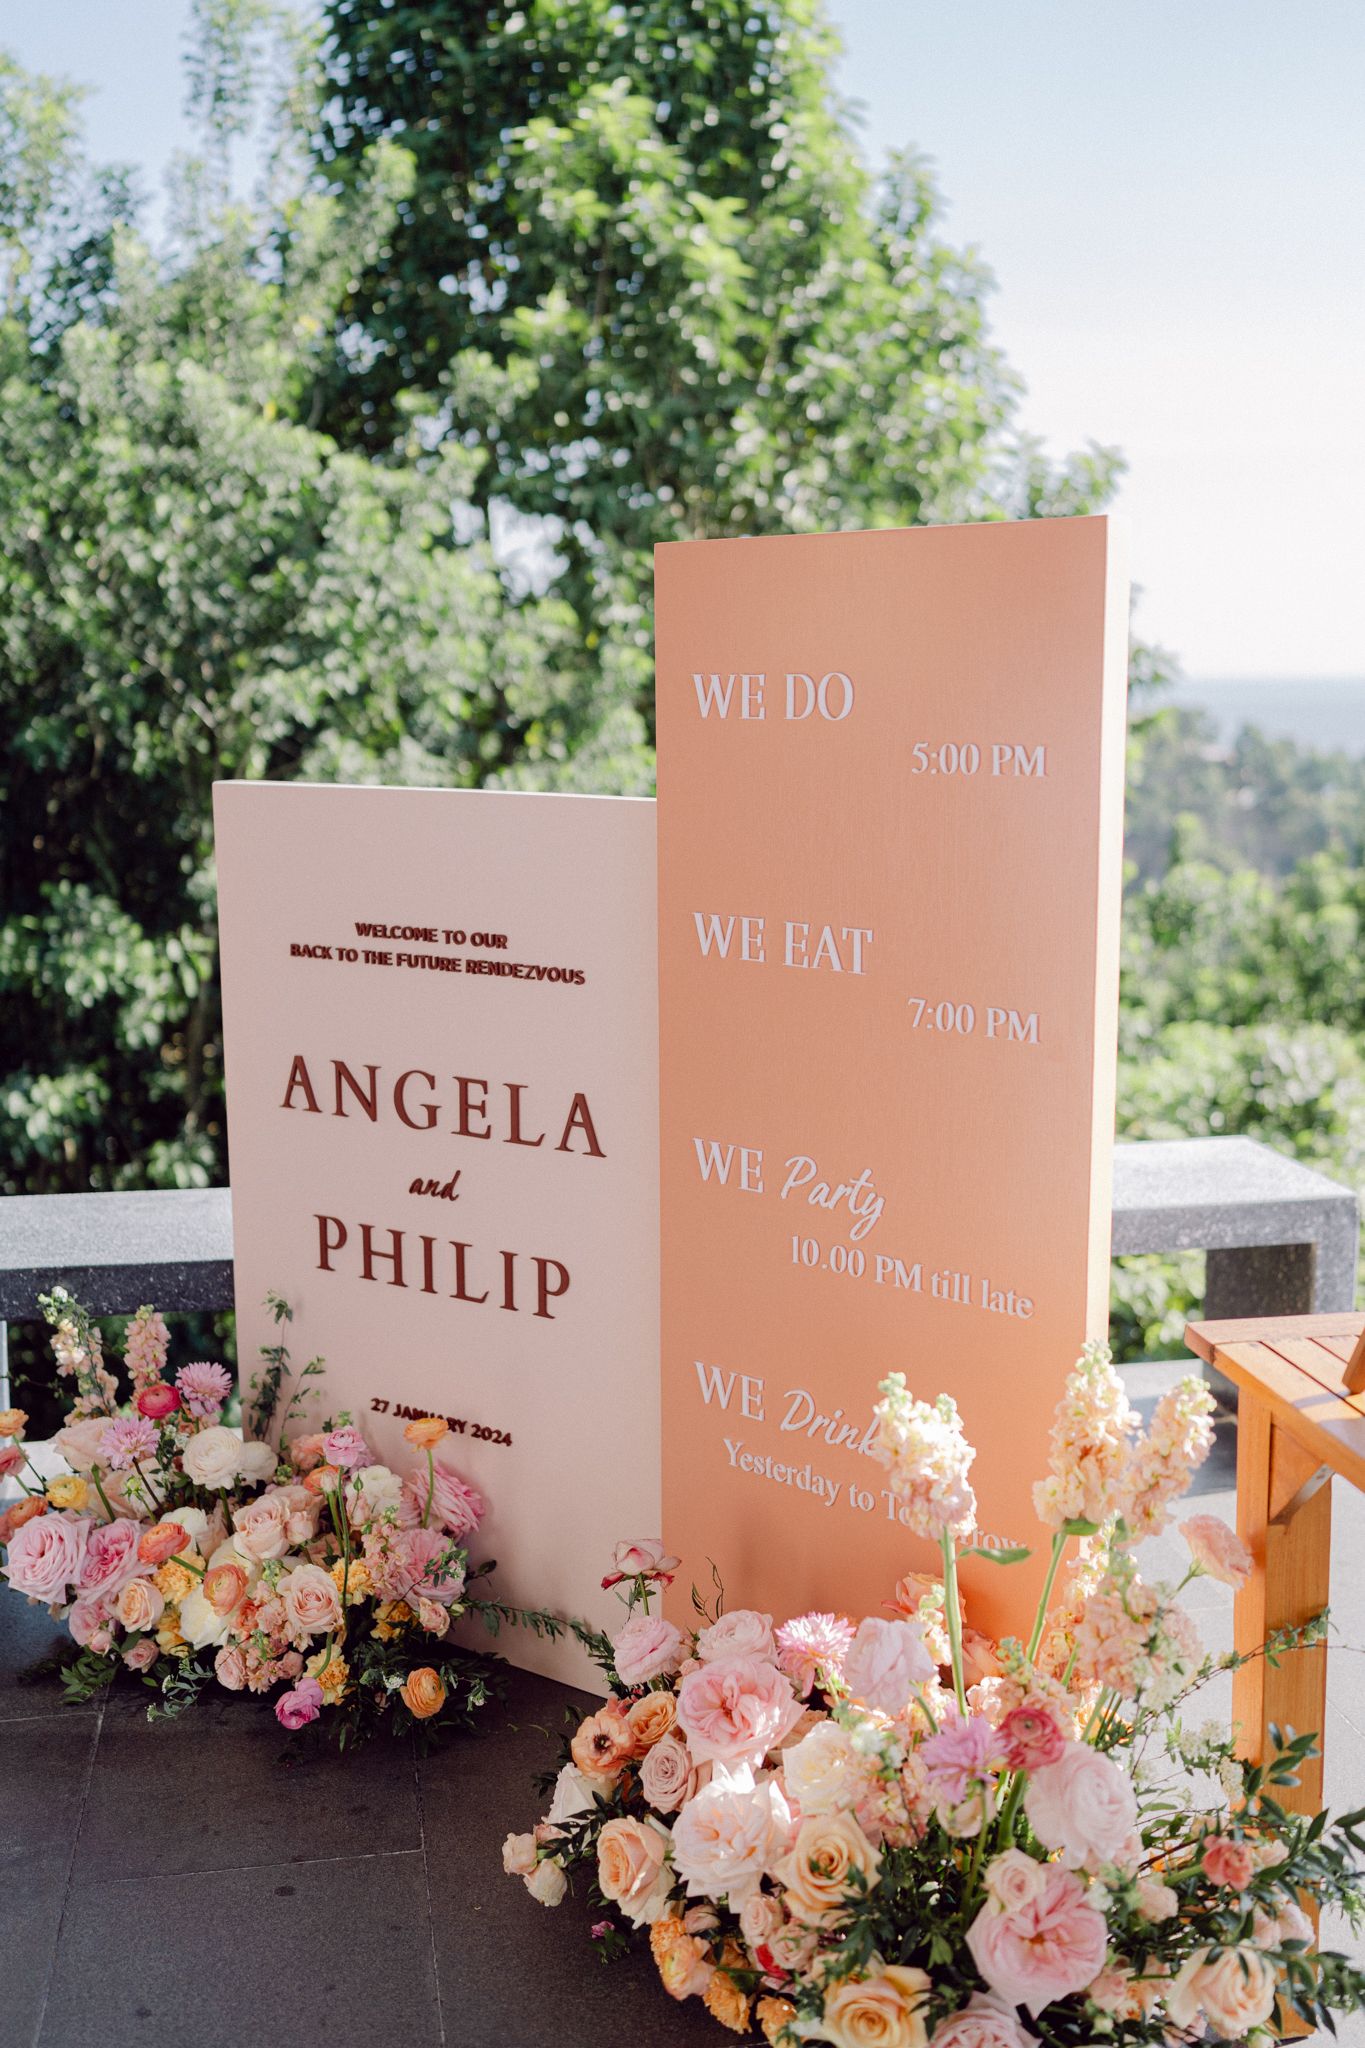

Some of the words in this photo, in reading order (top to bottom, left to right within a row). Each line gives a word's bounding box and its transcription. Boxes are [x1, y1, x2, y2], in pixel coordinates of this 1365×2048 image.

[692, 673, 766, 720] WE
[784, 672, 855, 721] DO
[911, 742, 980, 775] 5:00
[991, 744, 1047, 777] PM
[355, 922, 438, 943] WELCOME
[442, 930, 466, 945] TO
[470, 932, 508, 950] OUR
[692, 912, 766, 963] WE
[783, 921, 873, 975] EAT
[290, 943, 332, 960] BACK
[336, 947, 358, 963] TO
[362, 950, 392, 966] THE
[396, 953, 461, 973] FUTURE
[465, 959, 585, 985] RENDEZVOUS
[908, 998, 974, 1034] 7:00
[984, 1007, 1041, 1044] PM
[279, 1055, 607, 1158] ANGELA
[409, 1170, 461, 1201] and
[692, 1137, 764, 1193] WE
[780, 1156, 885, 1241] Party
[313, 1214, 570, 1319] PHILIP
[791, 1236, 866, 1277] 10.00
[874, 1254, 924, 1292] PM
[931, 1270, 971, 1304] till
[981, 1280, 1034, 1319] late
[694, 1361, 765, 1421] WE
[370, 1398, 390, 1413] 27
[393, 1404, 467, 1434] JANRY
[471, 1423, 512, 1446] 2024
[722, 1438, 841, 1507] Yesterday
[850, 1484, 875, 1512] to
